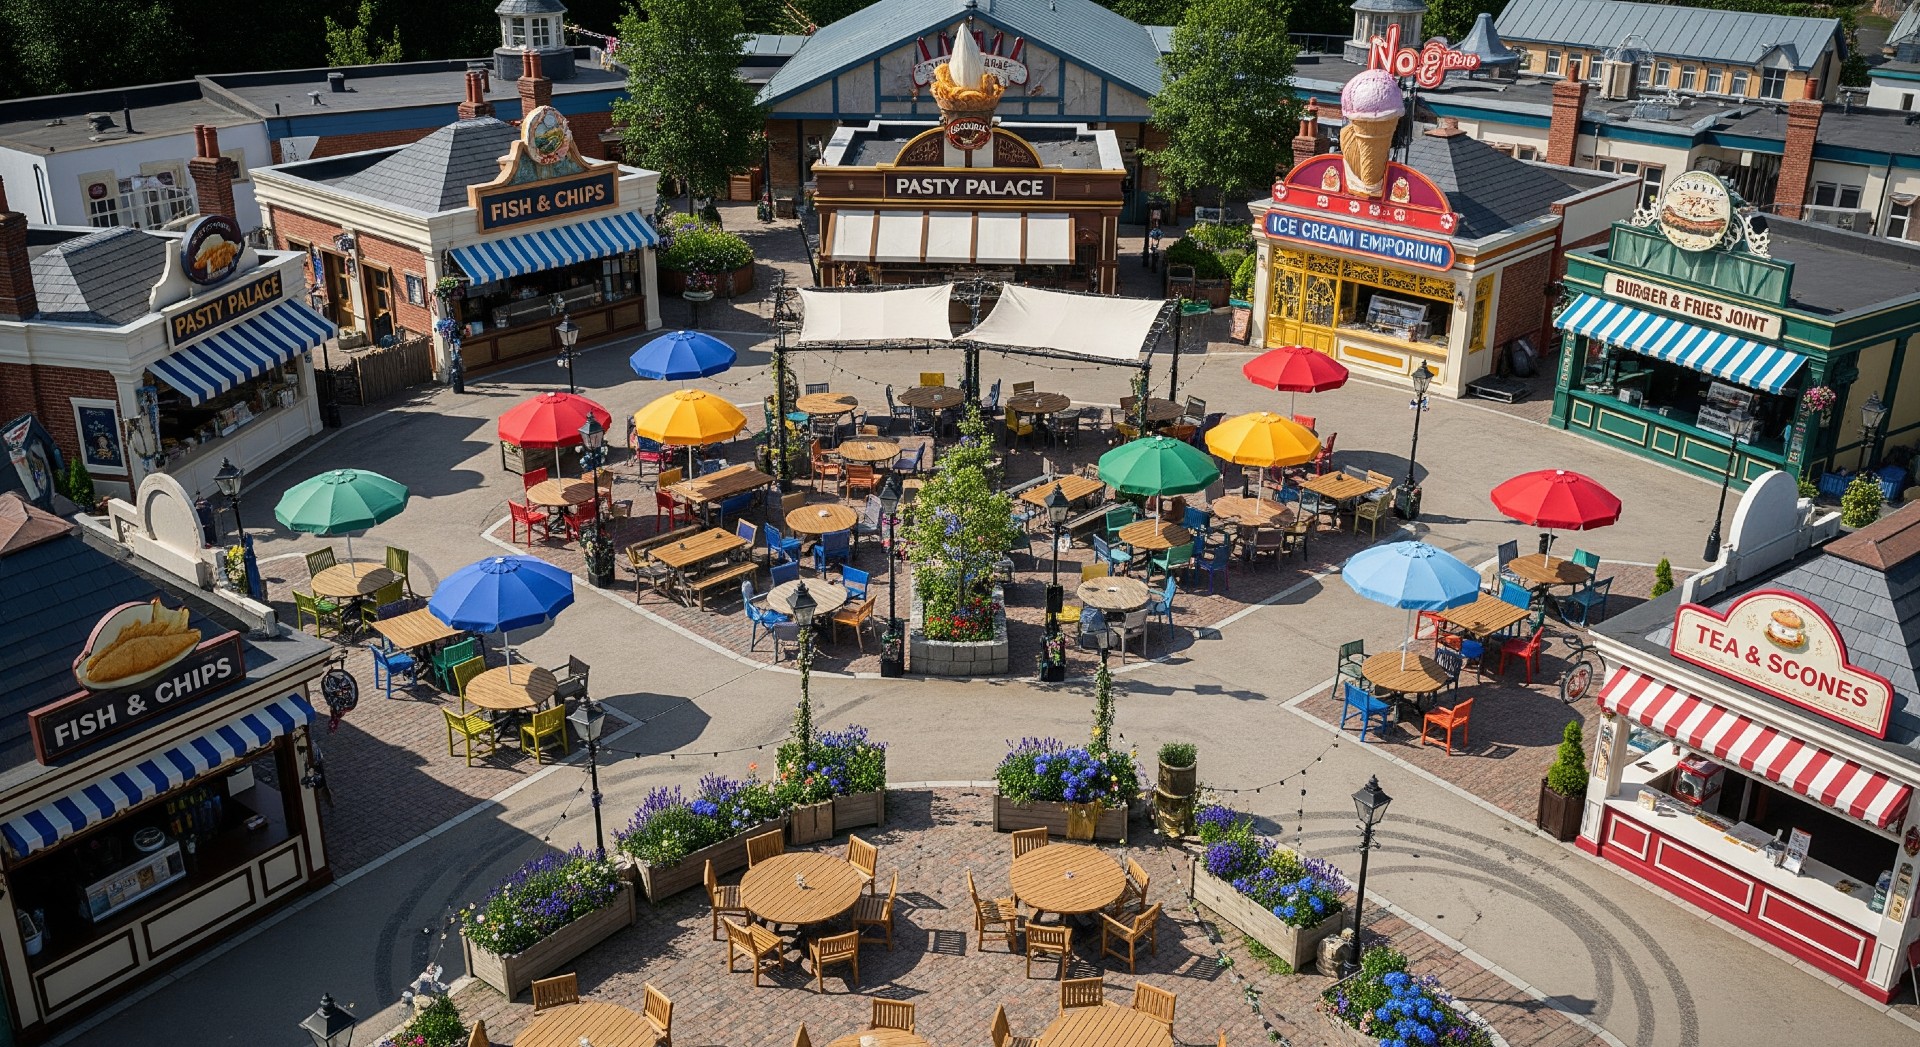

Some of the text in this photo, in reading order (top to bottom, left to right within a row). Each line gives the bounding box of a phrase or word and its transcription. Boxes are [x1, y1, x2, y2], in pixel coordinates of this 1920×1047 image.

[490, 183, 606, 222] FISH & CHIPS
[896, 178, 1044, 196] PASTY PALACE
[1272, 216, 1298, 235] ICE
[1301, 222, 1354, 248] CREAM
[175, 275, 280, 338] PASTY PALACE
[1615, 278, 1769, 333] BURGER & FRIES JOINT
[1696, 624, 1869, 707] TEA & SCONES
[54, 657, 232, 748] FISH & CHIPS
